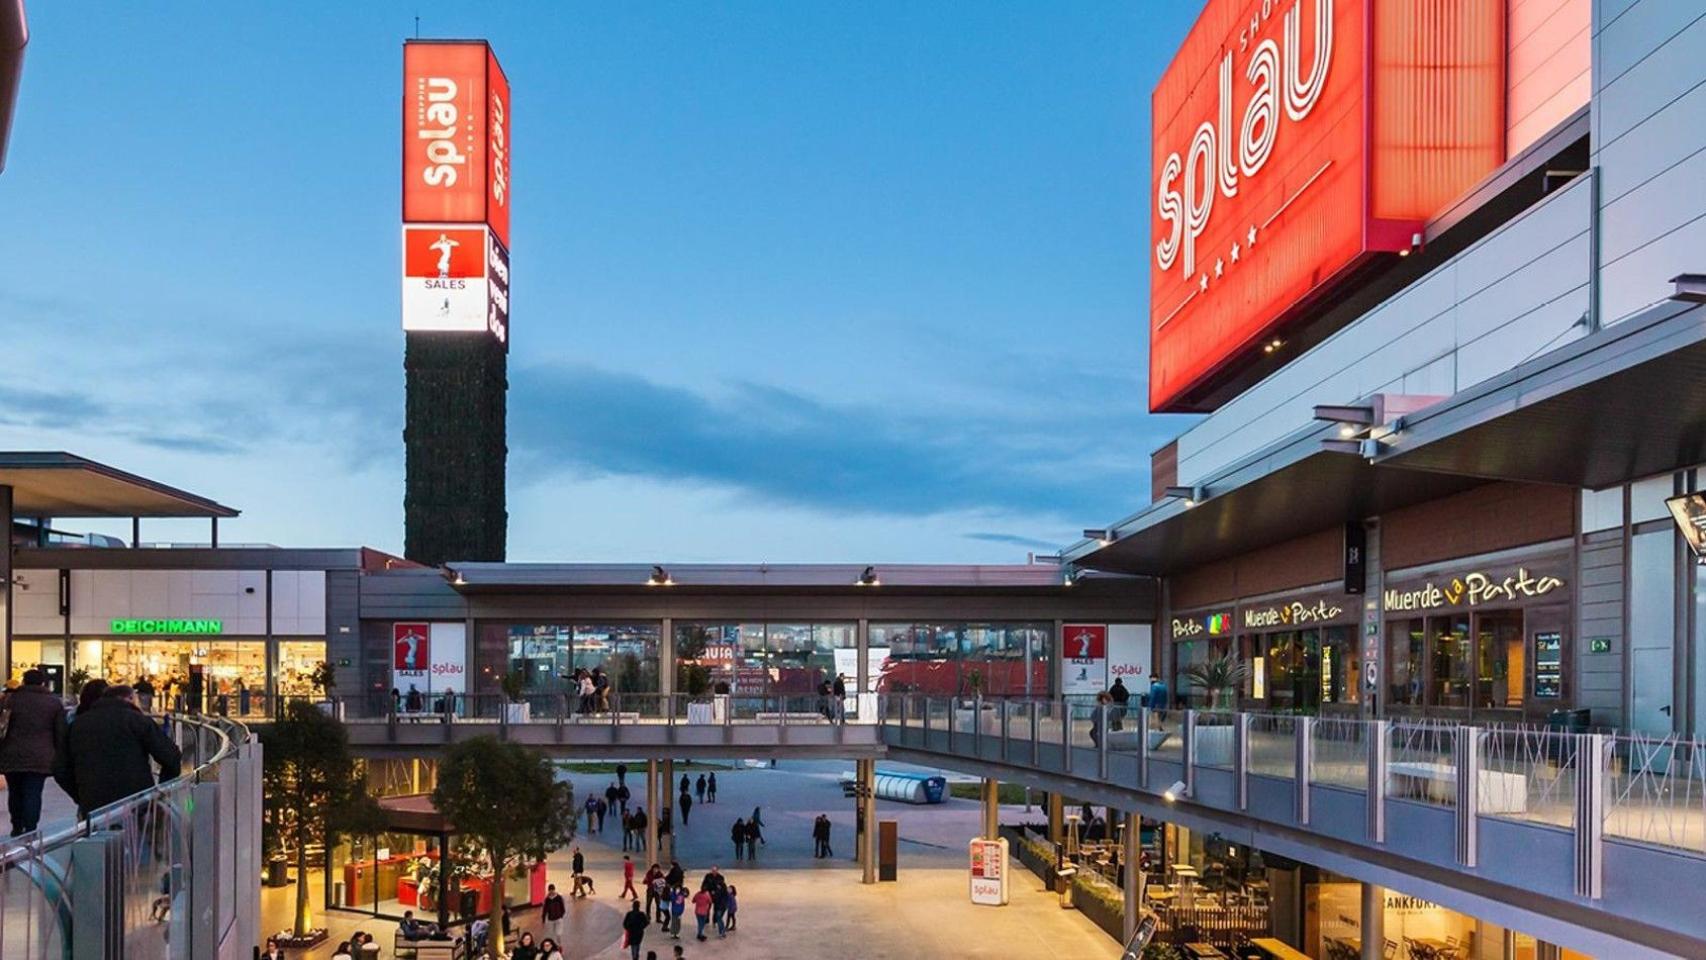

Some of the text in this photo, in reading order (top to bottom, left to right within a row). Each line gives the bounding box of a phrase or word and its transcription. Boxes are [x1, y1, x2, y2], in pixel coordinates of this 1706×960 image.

[419, 77, 466, 188] splau
[425, 279, 466, 290] SALES
[1384, 582, 1444, 611] Muerde
[1465, 567, 1564, 606] Pasta
[1245, 607, 1280, 627] Muerde
[1290, 600, 1342, 625] Pasta
[111, 619, 222, 634] DEICHMANN
[1172, 618, 1203, 638] Pasta
[432, 662, 463, 676] splau
[1112, 664, 1142, 676] splau
[974, 884, 999, 896] splau
